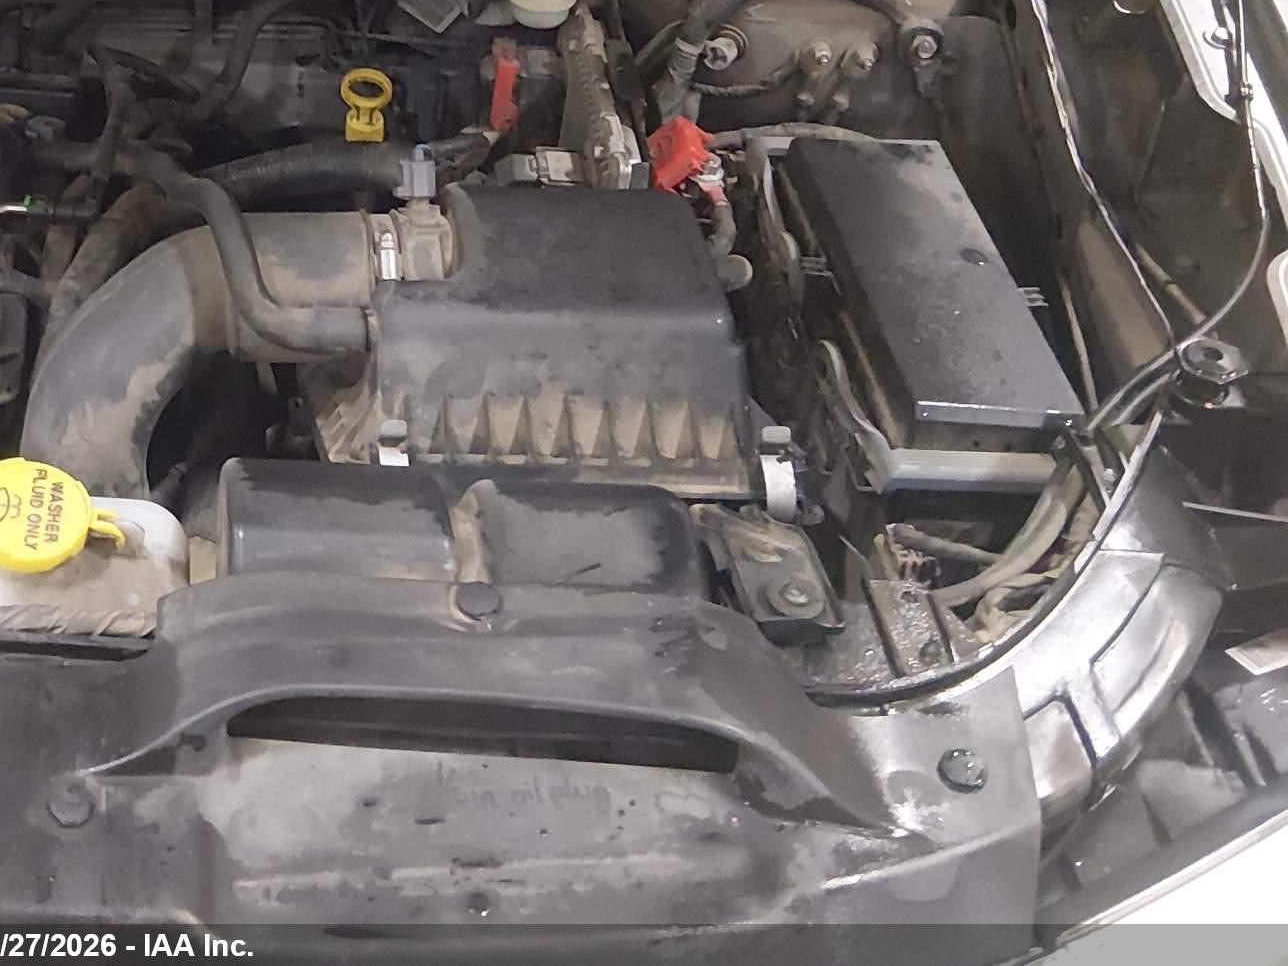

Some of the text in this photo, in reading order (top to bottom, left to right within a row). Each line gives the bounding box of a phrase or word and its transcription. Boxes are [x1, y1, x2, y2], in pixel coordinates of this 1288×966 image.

[24, 468, 48, 551] FLUID ONLY
[45, 481, 64, 543] WASHER
